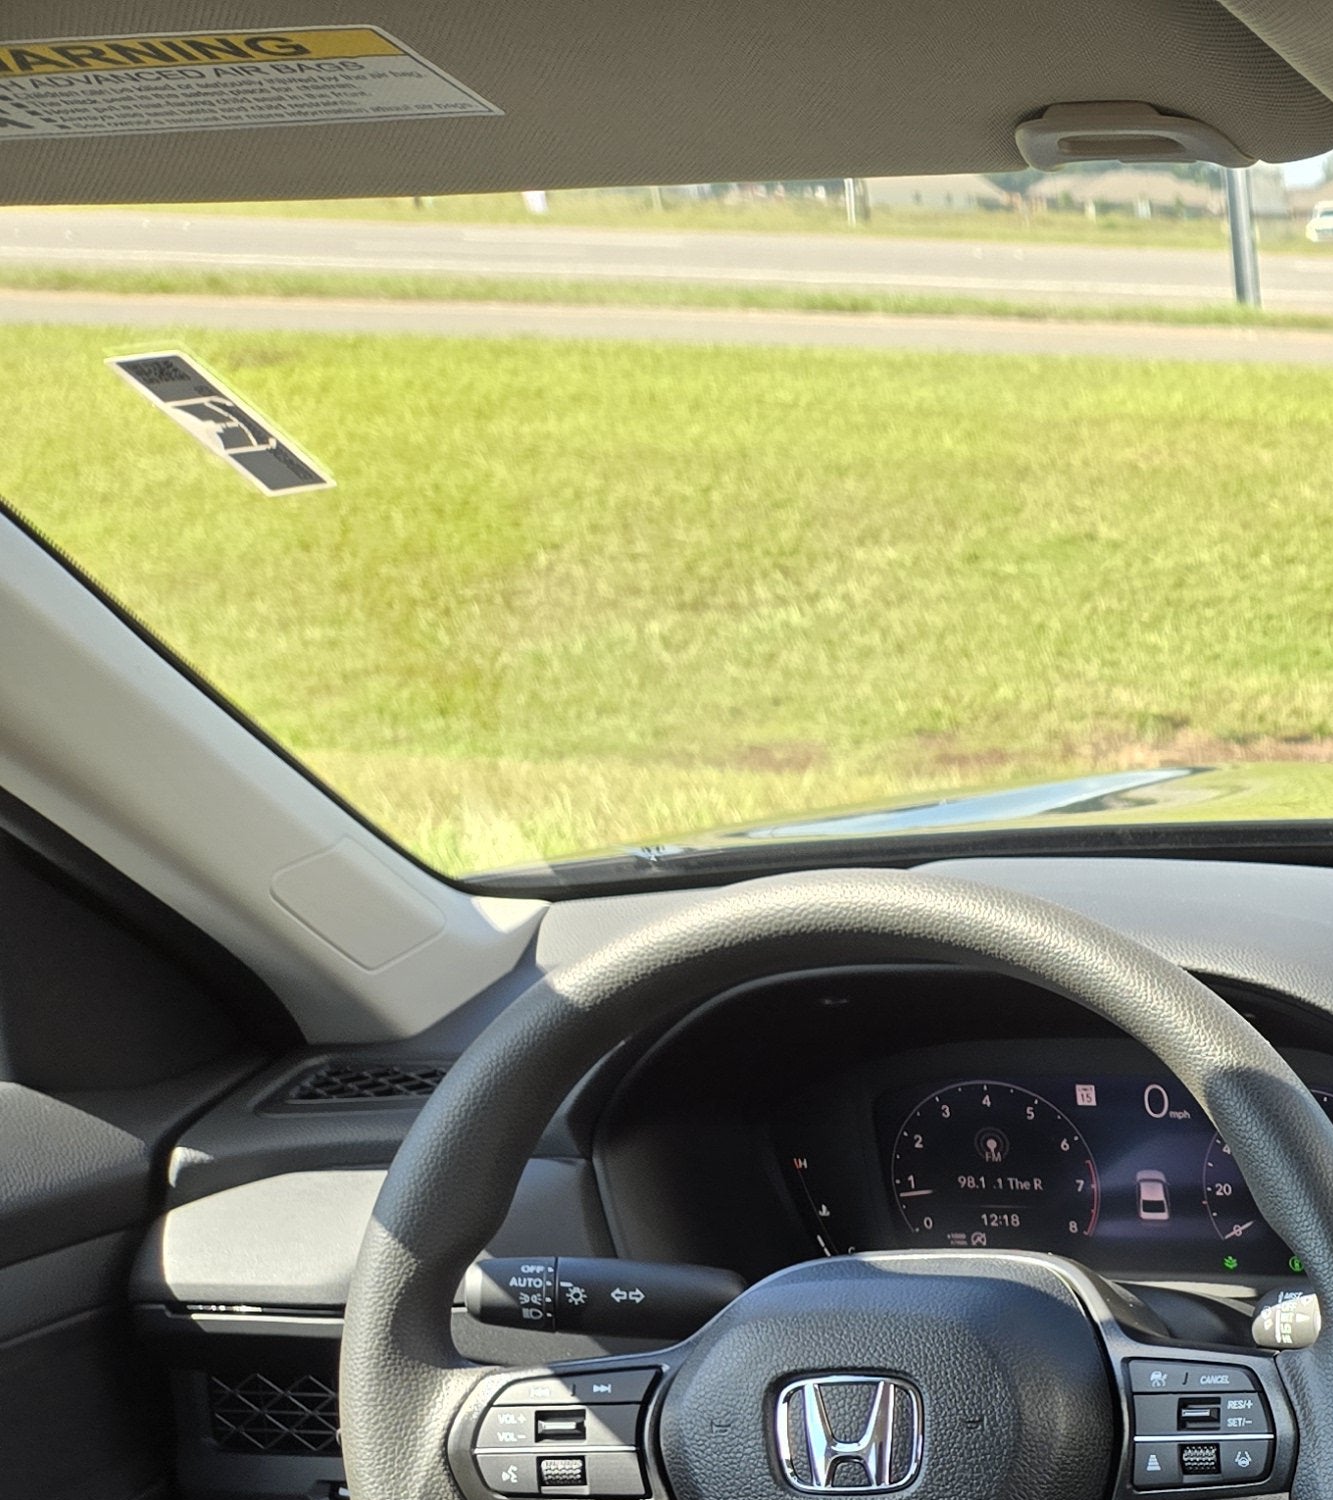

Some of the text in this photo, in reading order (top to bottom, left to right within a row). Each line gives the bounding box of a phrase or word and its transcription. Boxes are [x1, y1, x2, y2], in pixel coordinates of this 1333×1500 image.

[0, 36, 311, 72] ARNING
[30, 69, 206, 89] ADVANCED
[213, 64, 269, 78] AIR
[269, 61, 365, 75] BAGS
[982, 1095, 991, 1108] 4
[1080, 1092, 1093, 1104] 15
[1144, 1084, 1191, 1120] 0 mph
[941, 1104, 951, 1118] 3
[1025, 1107, 1035, 1120] 5
[913, 1135, 924, 1149] 2
[1060, 1139, 1070, 1151] 6
[985, 1152, 1002, 1163] FM
[907, 1176, 916, 1189] 1
[957, 1176, 986, 1189] 98.1
[1007, 1177, 1031, 1191] The
[1033, 1178, 1043, 1191] R
[1075, 1180, 1085, 1193] 7
[1215, 1183, 1232, 1196] 20
[923, 1216, 933, 1230] 0
[980, 1213, 1021, 1228] 12:18
[1068, 1220, 1078, 1234] 8
[521, 1264, 545, 1274] OFF
[509, 1276, 543, 1288] AUTO
[1200, 1375, 1230, 1384] CANCEL
[1227, 1400, 1253, 1410] RES/+
[498, 1413, 526, 1424] VOL+
